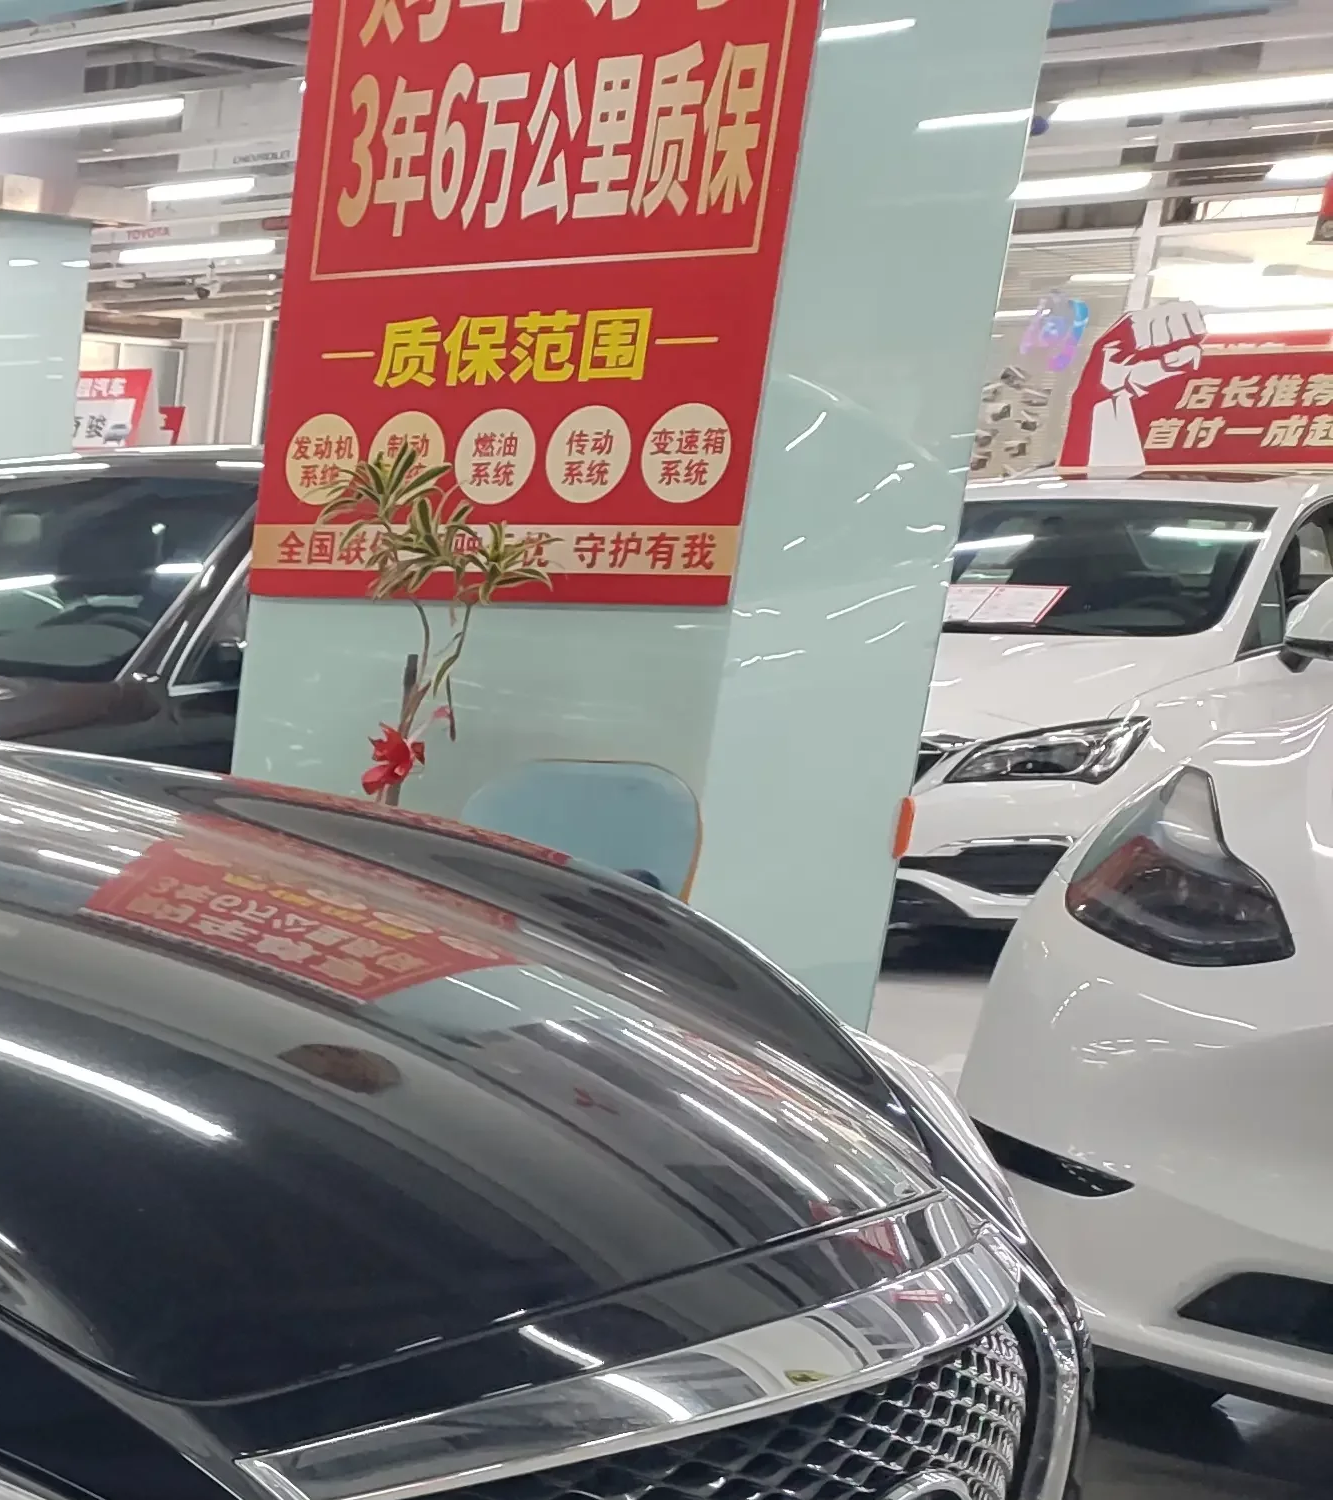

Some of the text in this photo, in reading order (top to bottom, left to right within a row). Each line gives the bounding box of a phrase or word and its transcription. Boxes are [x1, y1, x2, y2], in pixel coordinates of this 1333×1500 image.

[336, 40, 770, 238] 3年6万公里质保
[127, 226, 171, 241] TOYOTA
[373, 307, 654, 389] 质保范围
[1175, 373, 1333, 410] 店长推荐
[472, 431, 518, 458] 燃油
[566, 428, 614, 456] 传动
[649, 427, 728, 456] 变速箱
[1144, 414, 1333, 449] 首付一成起
[291, 435, 355, 461] 发动机
[469, 461, 516, 488] 系统
[561, 459, 611, 486] 系统
[658, 459, 710, 486] 系统
[572, 531, 718, 571] 守护有我
